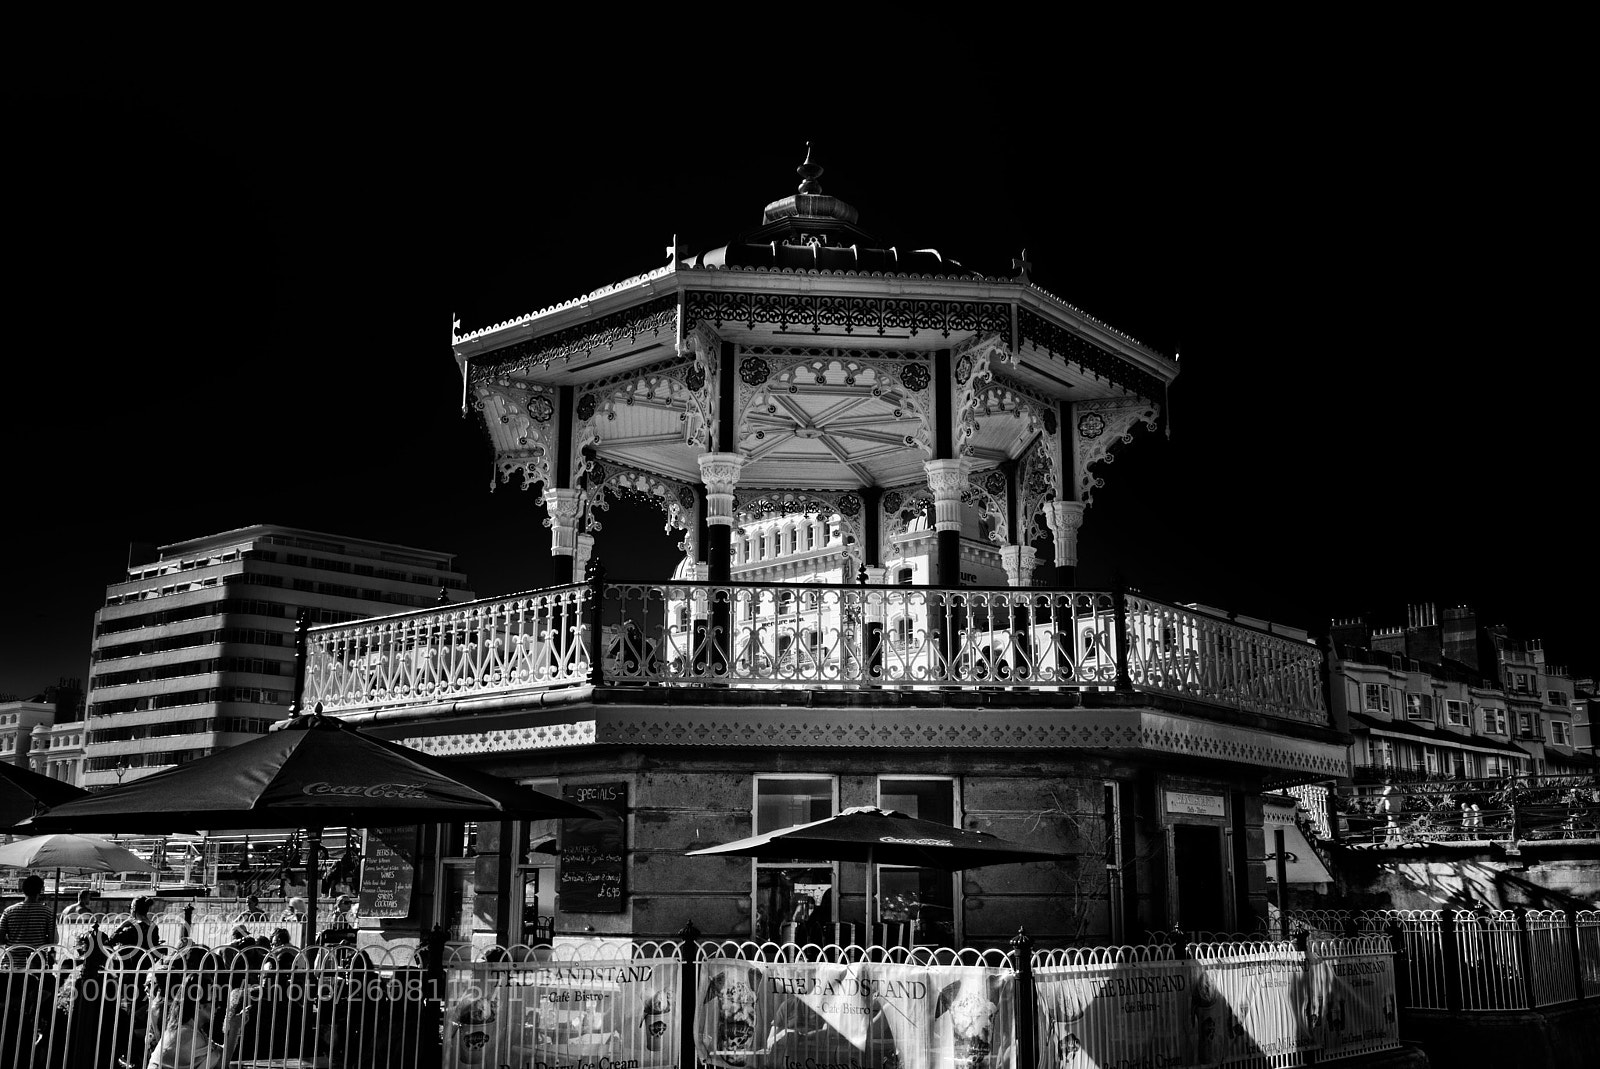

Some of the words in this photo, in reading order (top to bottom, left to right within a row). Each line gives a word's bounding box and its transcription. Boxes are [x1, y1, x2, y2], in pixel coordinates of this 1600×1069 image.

[302, 781, 429, 799] Coca-Cola
[879, 836, 954, 847] Coca-Cola
[491, 969, 534, 988] THE
[539, 965, 652, 986] BANDSTAND
[1090, 979, 1116, 999] THE
[1116, 974, 1186, 997] BANDSTAND
[768, 976, 806, 995] THE
[811, 977, 927, 1000] BANDSTAND
[598, 1056, 639, 1069] Cream
